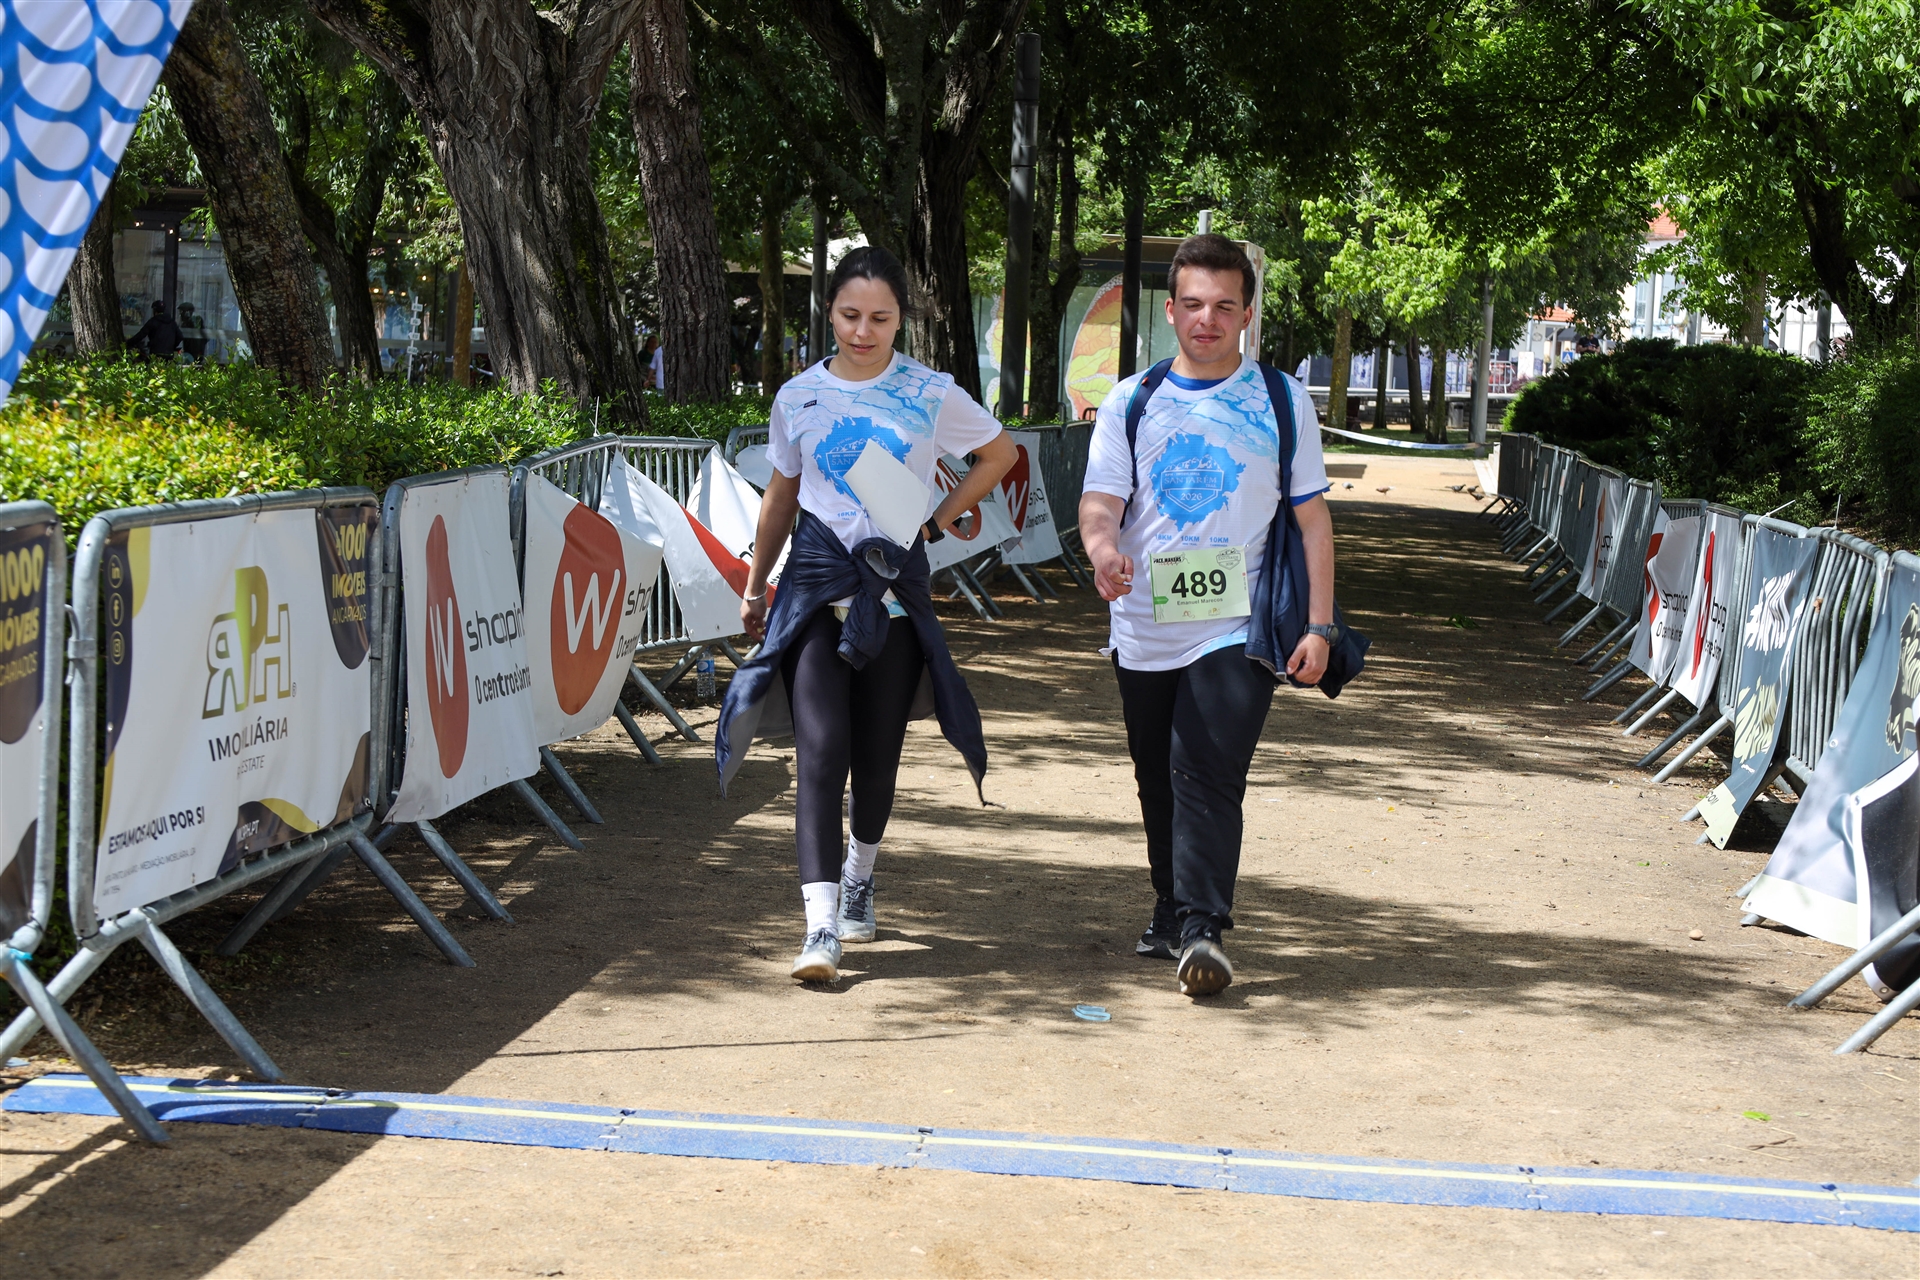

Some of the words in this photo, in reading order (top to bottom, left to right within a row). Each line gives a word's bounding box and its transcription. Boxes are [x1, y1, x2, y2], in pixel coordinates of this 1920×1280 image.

[1164, 475, 1217, 485] SANTARÉM
[1181, 493, 1203, 501] 2026
[1171, 569, 1227, 598] 489
[475, 674, 482, 705] O
[168, 809, 195, 832] POR
[196, 805, 205, 825] SI
